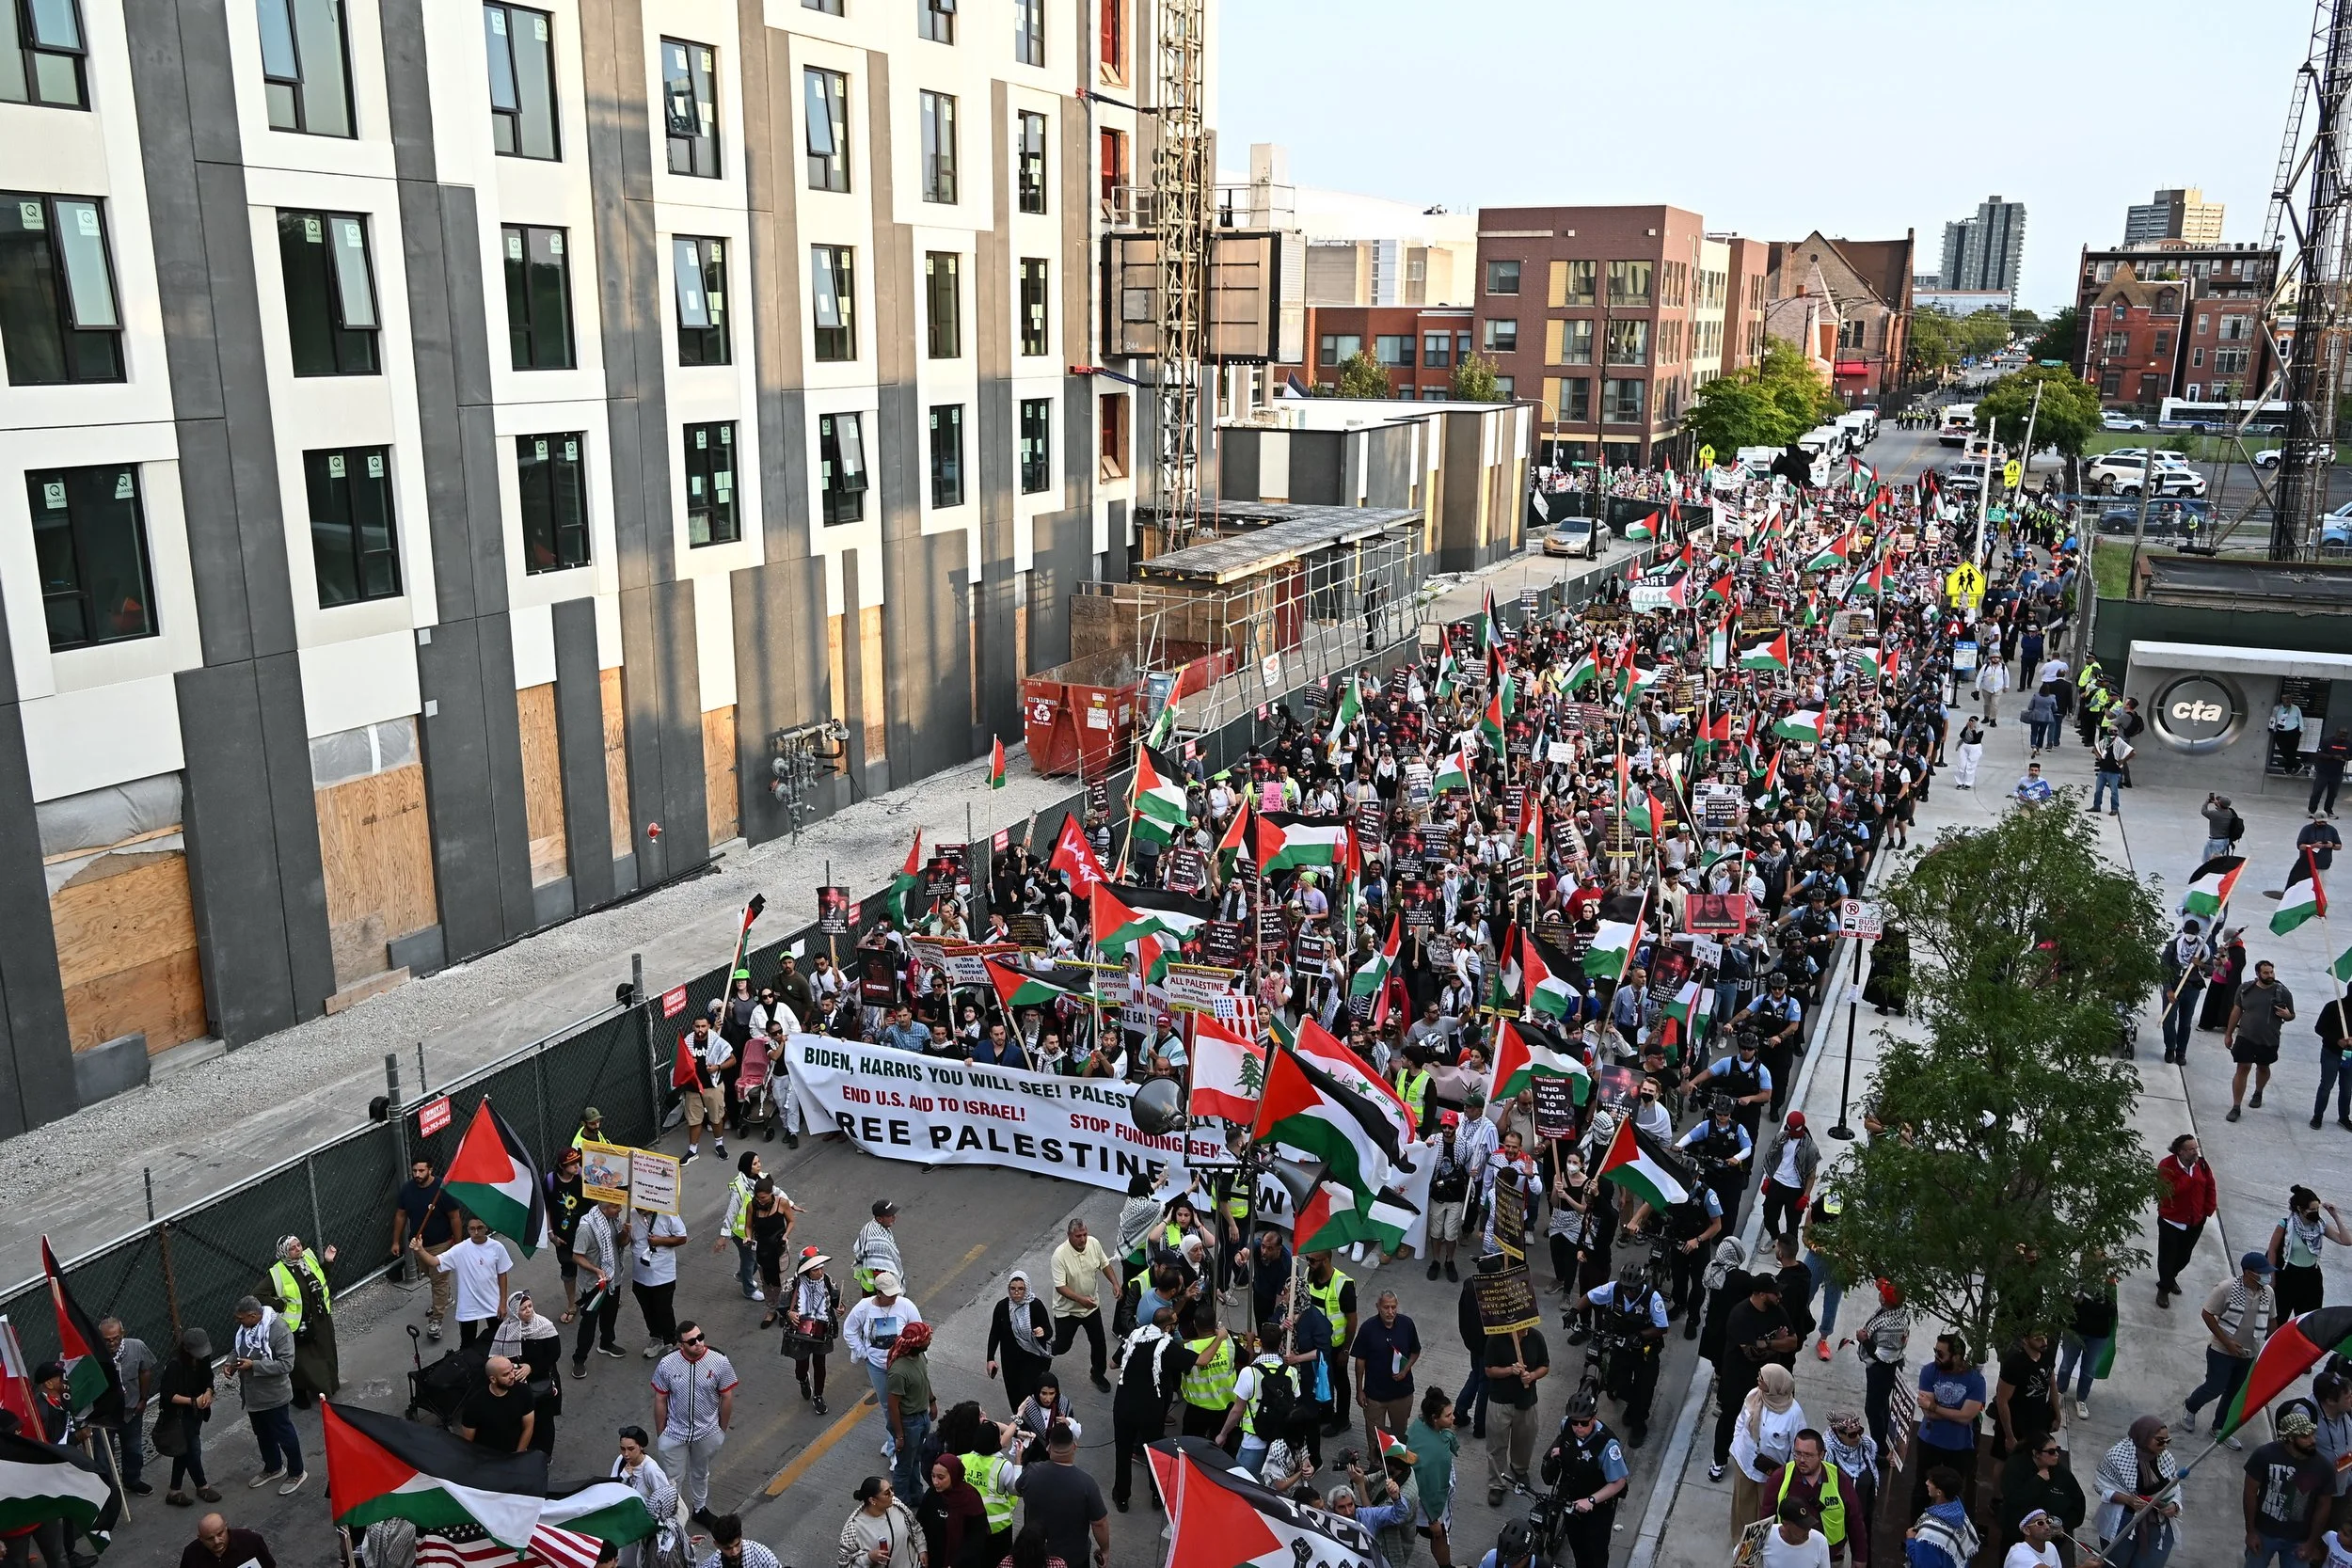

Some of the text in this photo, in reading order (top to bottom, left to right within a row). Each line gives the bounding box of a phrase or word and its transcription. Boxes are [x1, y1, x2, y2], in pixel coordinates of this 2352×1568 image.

[1126, 341, 1138, 350] 244
[1949, 624, 1960, 634] A
[2172, 699, 2222, 722] cta
[1173, 869, 1195, 878] ISRAEL
[1858, 918, 1875, 927] BUS
[1858, 925, 1879, 933] STOP
[1301, 940, 1311, 949] THE
[946, 947, 977, 956] Judaism
[1197, 969, 1229, 979] Demands
[1094, 980, 1129, 990] epresent
[1169, 977, 1224, 991] ALL PALESTINE
[1655, 984, 1678, 994] DEMOCRA
[1133, 990, 1144, 1005] IN
[1651, 990, 1673, 1000] GENOCI
[804, 1046, 1135, 1110] BIDEN, HARRIS YOU WILL SEE! PALEST
[842, 1085, 1026, 1122] END U.S. AID TO ISRAEL!
[1537, 1107, 1567, 1116] ISRAEL
[1070, 1113, 1184, 1153] STOP FUNDING
[834, 1108, 1286, 1214] REE PALESTINE NW
[1482, 1282, 1519, 1295] DEMOCRATS
[1494, 1279, 1512, 1288] BOTH
[1484, 1289, 1528, 1303] REPUBLICANS
[1500, 1298, 1521, 1308] BLOOD
[1488, 1303, 1531, 1317] THEIR HANDS!
[2268, 1463, 2296, 1481] IT'S
[1824, 1496, 1839, 1507] CRS
[1742, 1523, 1762, 1542] NO
